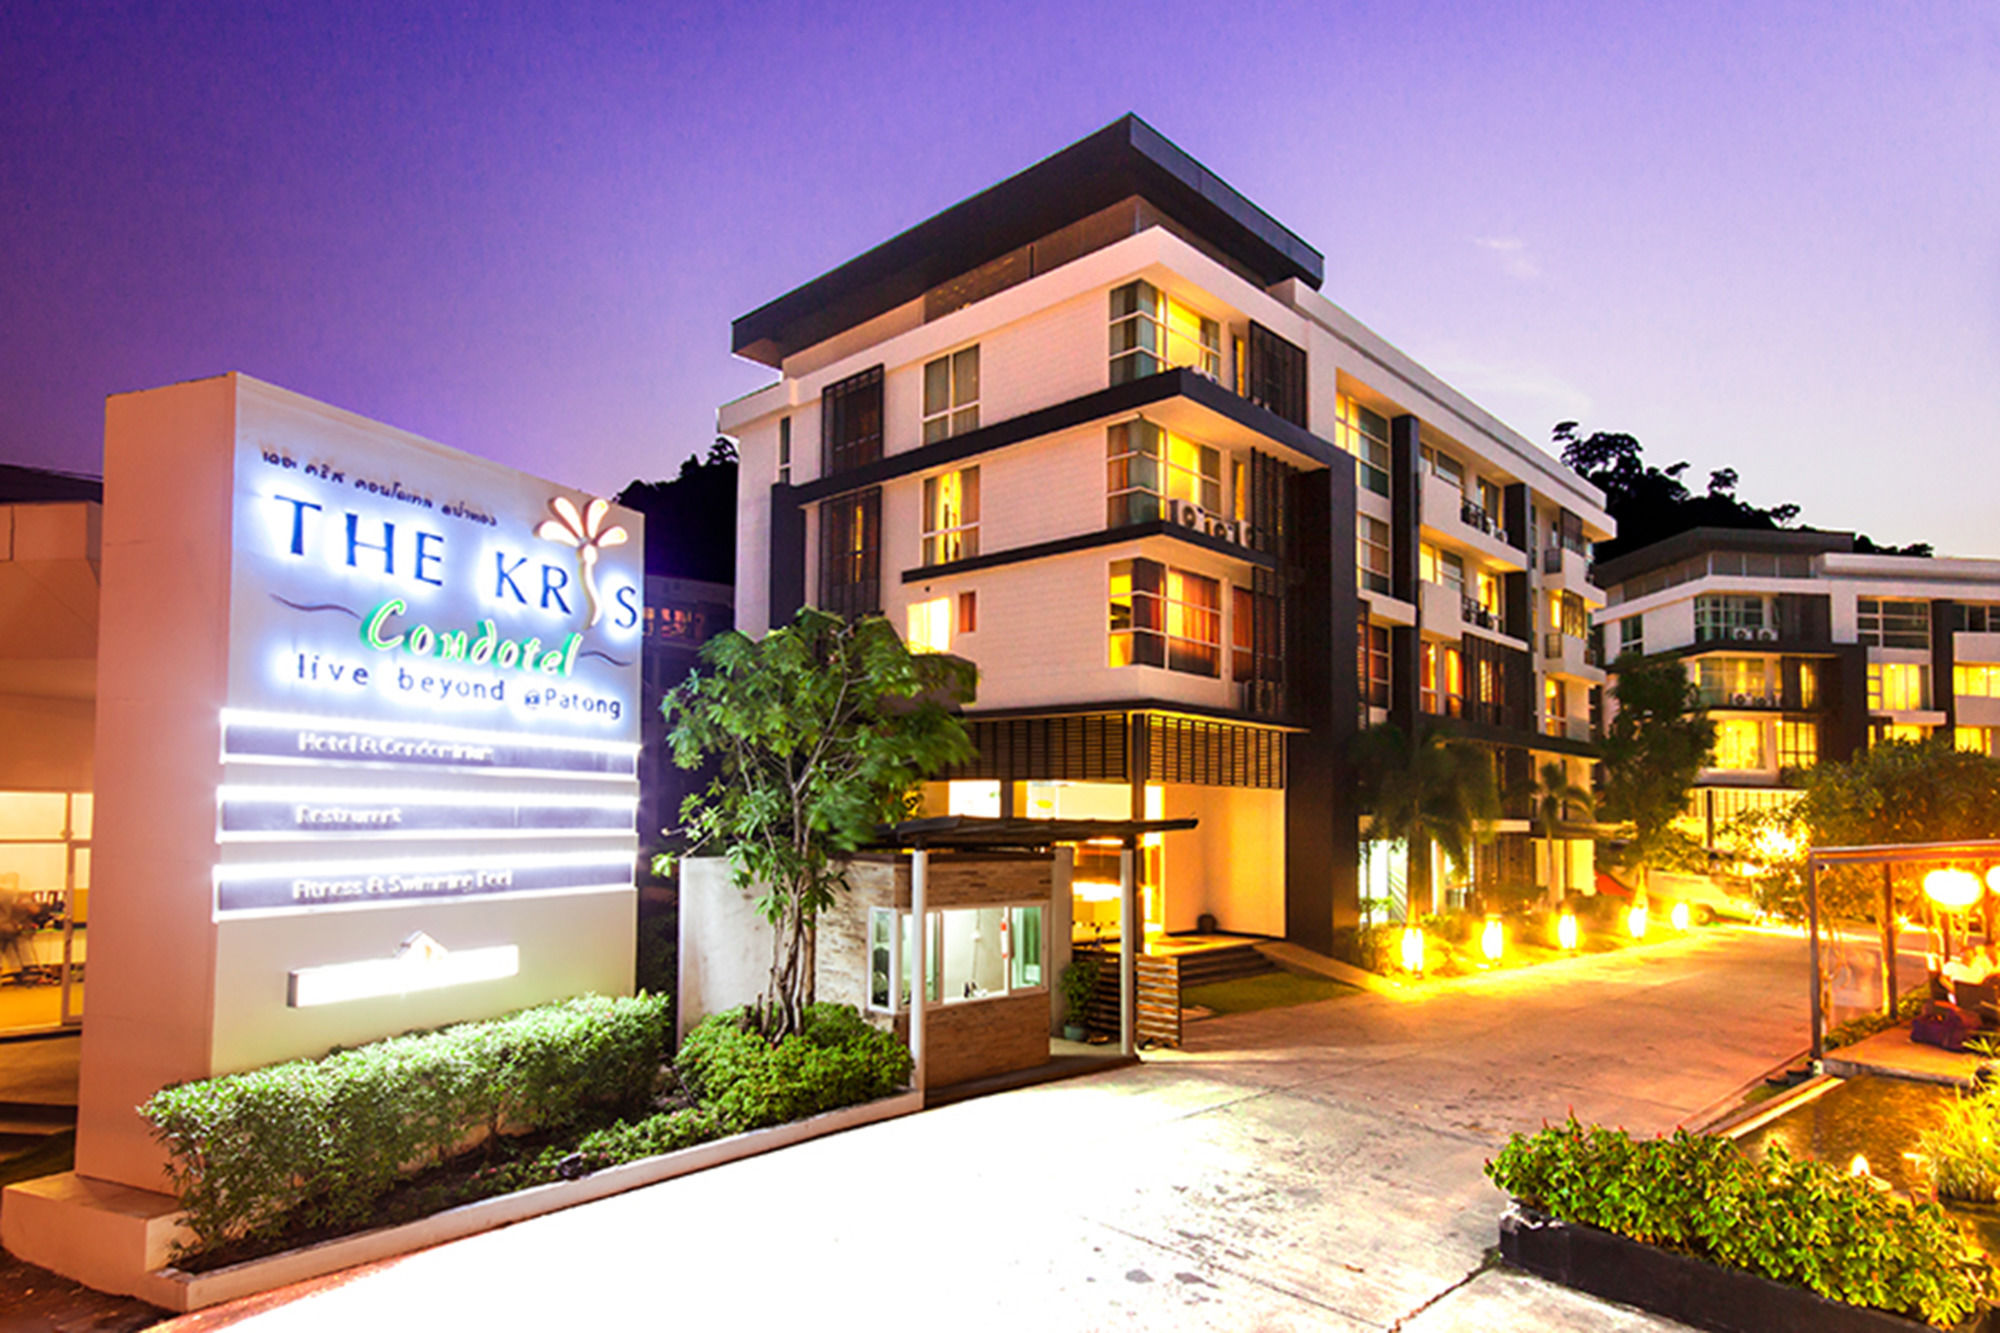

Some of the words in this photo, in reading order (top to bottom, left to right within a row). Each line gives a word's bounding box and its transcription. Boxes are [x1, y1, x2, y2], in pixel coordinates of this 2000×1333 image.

[274, 493, 445, 587] THE
[359, 599, 583, 677] Condotel
[298, 653, 370, 687] live
[397, 666, 505, 701] beyond
[523, 686, 622, 720] @Patong
[298, 730, 359, 755] Hotel
